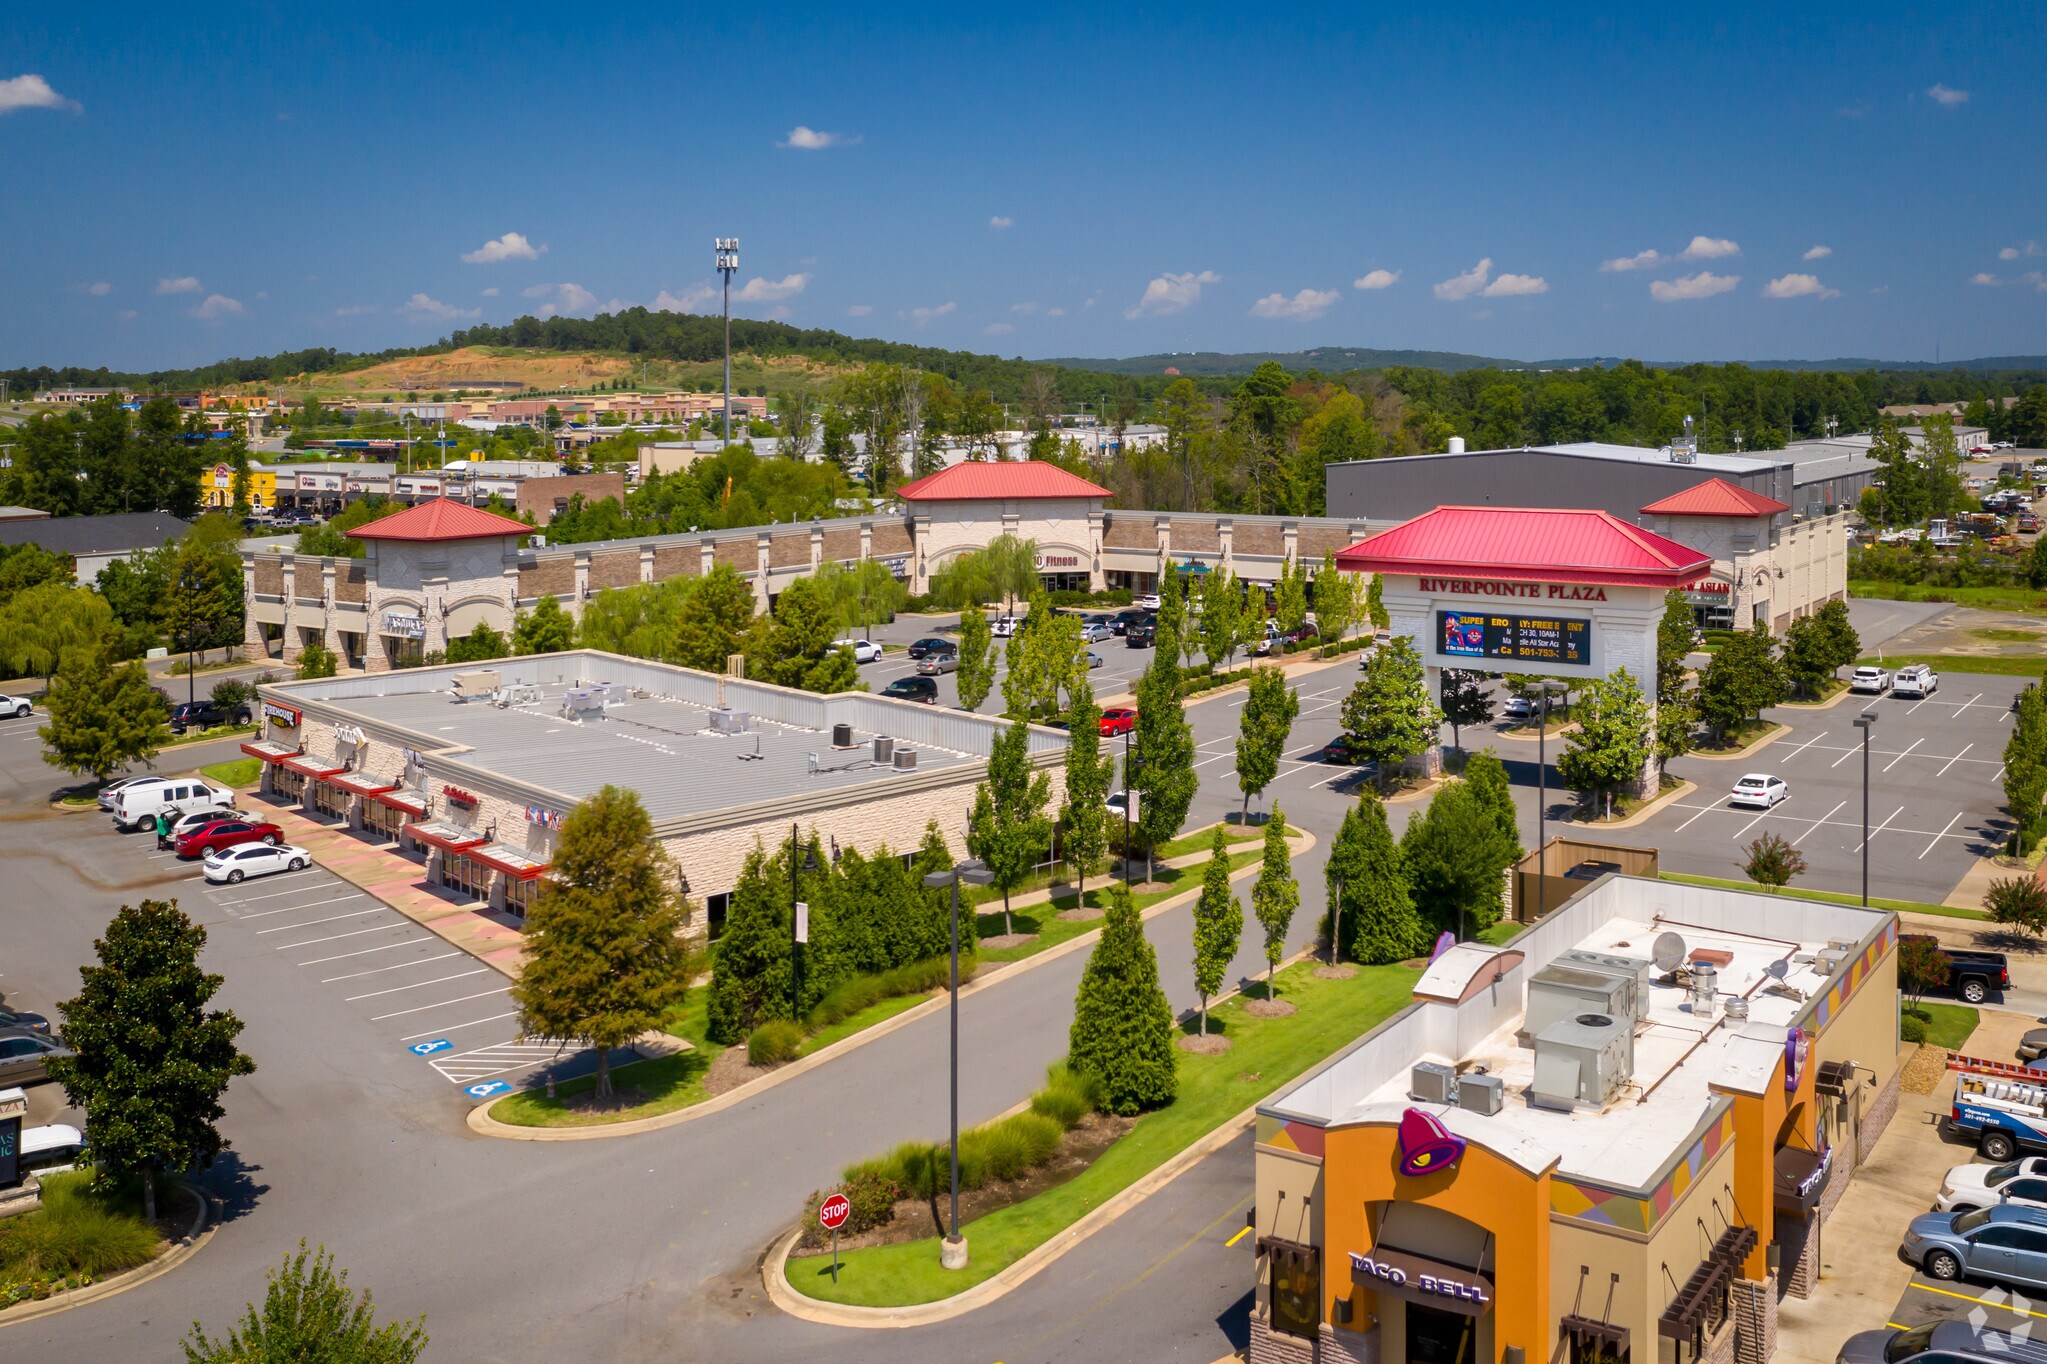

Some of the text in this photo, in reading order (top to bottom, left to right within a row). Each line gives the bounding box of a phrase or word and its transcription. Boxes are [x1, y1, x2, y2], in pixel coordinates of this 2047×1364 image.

[1045, 555, 1078, 567] Fitness
[1419, 578, 1608, 602] RIVERPOINTE PLAZA
[1699, 581, 1730, 593] ASIAN
[1490, 618, 1509, 627] ERO
[1531, 620, 1553, 630] FREE
[1501, 646, 1512, 655] Ca
[264, 703, 294, 727] FIREHOUSE
[823, 1202, 848, 1220] STOP
[1347, 1251, 1489, 1301] TACO BELL
